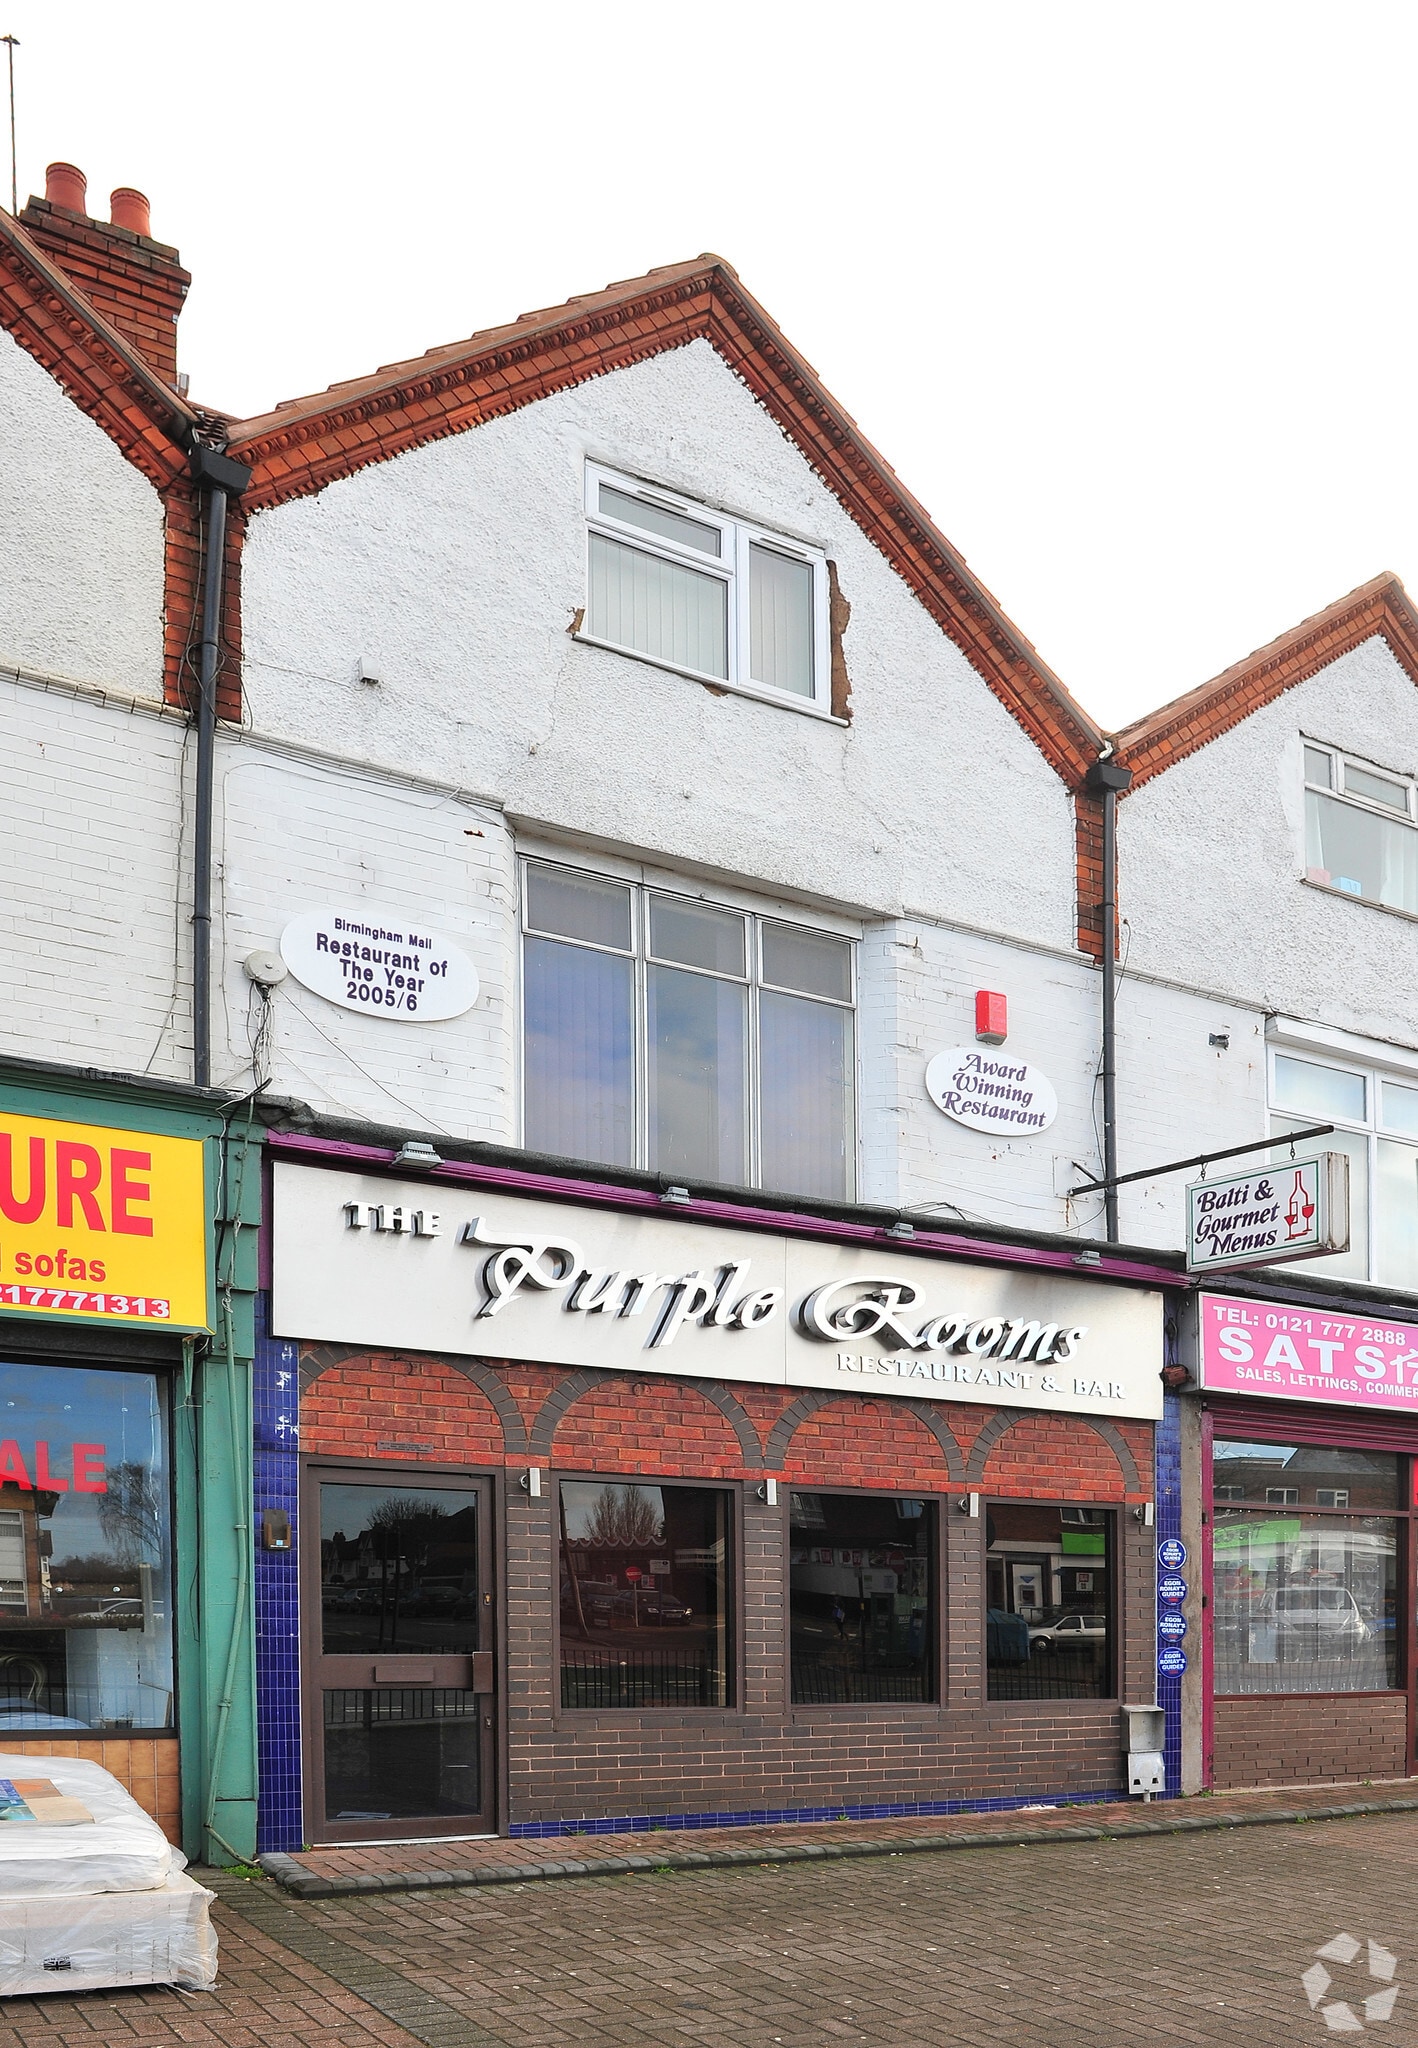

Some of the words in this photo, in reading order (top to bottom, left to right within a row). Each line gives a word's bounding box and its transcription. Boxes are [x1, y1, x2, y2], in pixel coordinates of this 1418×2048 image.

[335, 918, 402, 943] Birmingham
[409, 934, 432, 950] Mail
[316, 932, 420, 972] Restaurant
[429, 960, 448, 977] of
[340, 958, 374, 982] The
[384, 968, 425, 993] Year
[347, 981, 418, 1011] 2005/6
[958, 1053, 1028, 1082] Award
[952, 1072, 1034, 1108] Winning
[942, 1091, 1047, 1128] Restaurant
[0, 1133, 154, 1237] URE
[1197, 1184, 1250, 1213] Balti
[1254, 1179, 1274, 1201] &
[1195, 1201, 1280, 1244] Gourmet
[1208, 1230, 1278, 1257] Menus
[15, 1249, 107, 1282] sofas
[344, 1200, 443, 1238] THE
[464, 1216, 784, 1350] Purple
[804, 1275, 1089, 1365] Rooms
[0, 1285, 170, 1318] 17771313
[1213, 1305, 1259, 1327] TEL:
[1265, 1314, 1312, 1334] 0121
[1320, 1321, 1356, 1339] 777
[1362, 1327, 1406, 1346] 2888
[1218, 1326, 1387, 1380] SATS
[837, 1353, 1034, 1390] RESTAURANT
[1041, 1374, 1067, 1394] &
[1074, 1378, 1127, 1400] BAR
[1235, 1366, 1286, 1386] SALES,
[1290, 1373, 1362, 1395] LETTINGS,
[1365, 1381, 1418, 1398] COMMER
